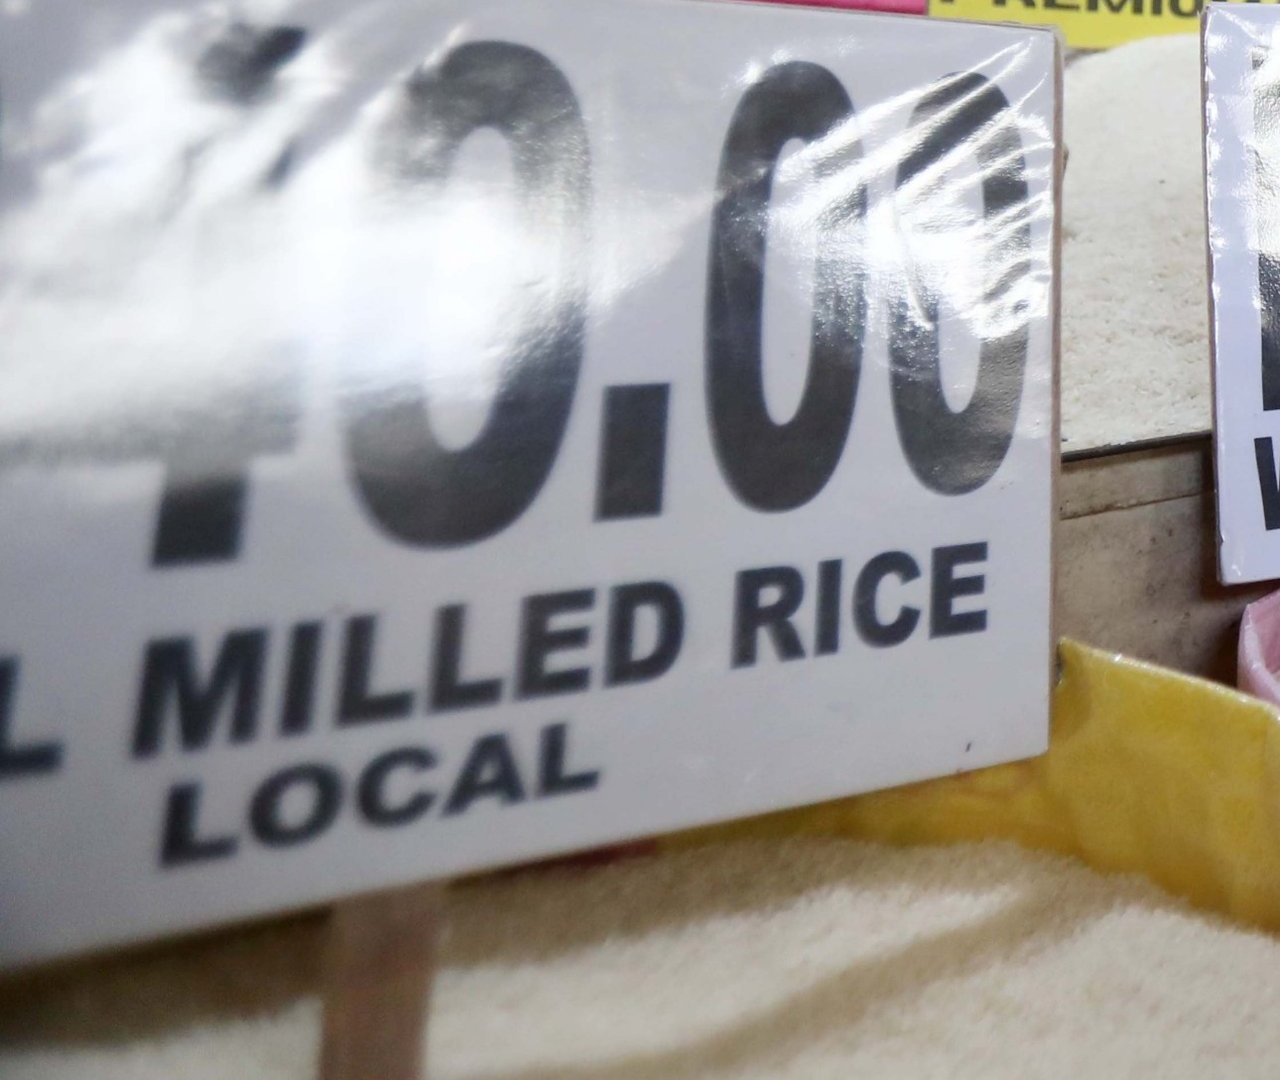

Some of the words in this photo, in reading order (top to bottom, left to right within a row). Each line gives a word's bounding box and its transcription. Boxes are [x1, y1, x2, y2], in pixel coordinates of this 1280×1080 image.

[129, 580, 685, 761] MILLED
[730, 541, 989, 669] RICE
[159, 720, 603, 869] LOCAL
